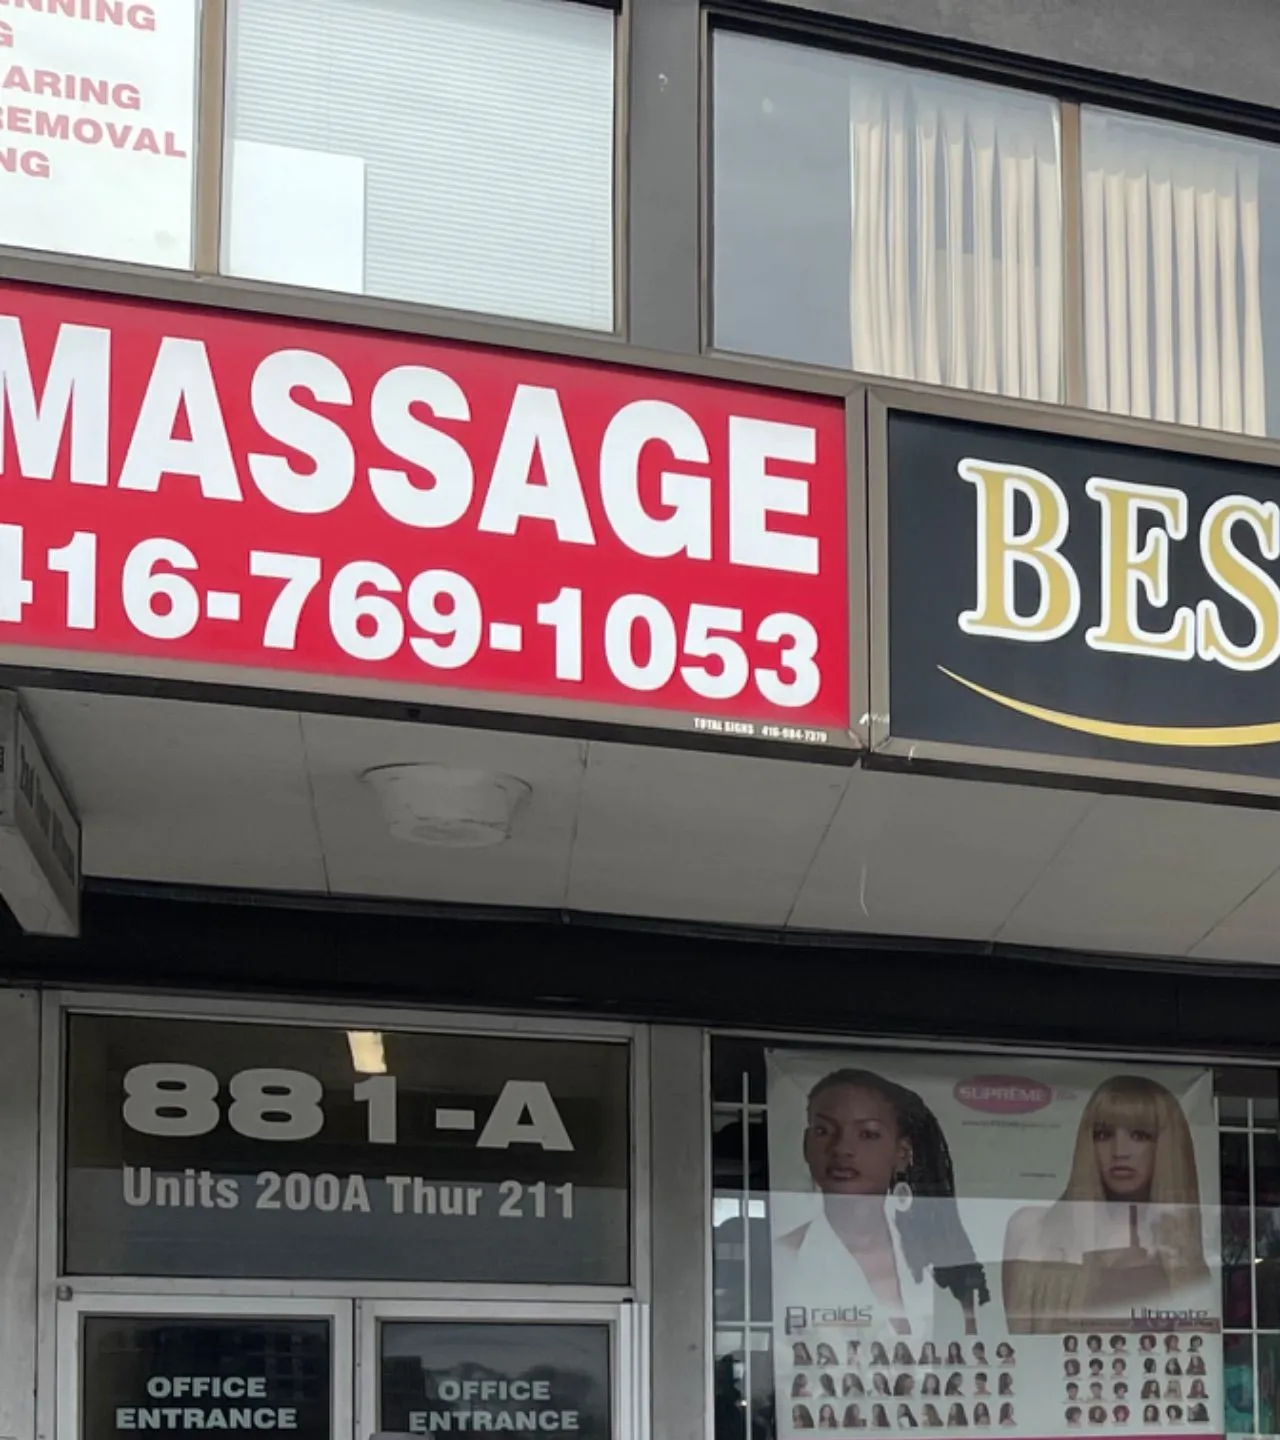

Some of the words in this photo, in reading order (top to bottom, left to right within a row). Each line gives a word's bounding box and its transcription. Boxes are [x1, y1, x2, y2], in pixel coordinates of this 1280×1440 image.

[0, 105, 187, 158] EMOVAL
[0, 315, 821, 576] MASSAGE
[122, 1062, 575, 1152] 881-A
[122, 1164, 239, 1209] Units
[255, 1170, 370, 1214] 200A
[385, 1176, 482, 1217] Thur
[498, 1181, 574, 1220] 211
[146, 1376, 267, 1400] OFFICE
[438, 1380, 551, 1403] OFFICE
[115, 1407, 298, 1431] ENTRANCE
[408, 1410, 580, 1434] ENTRANCE
